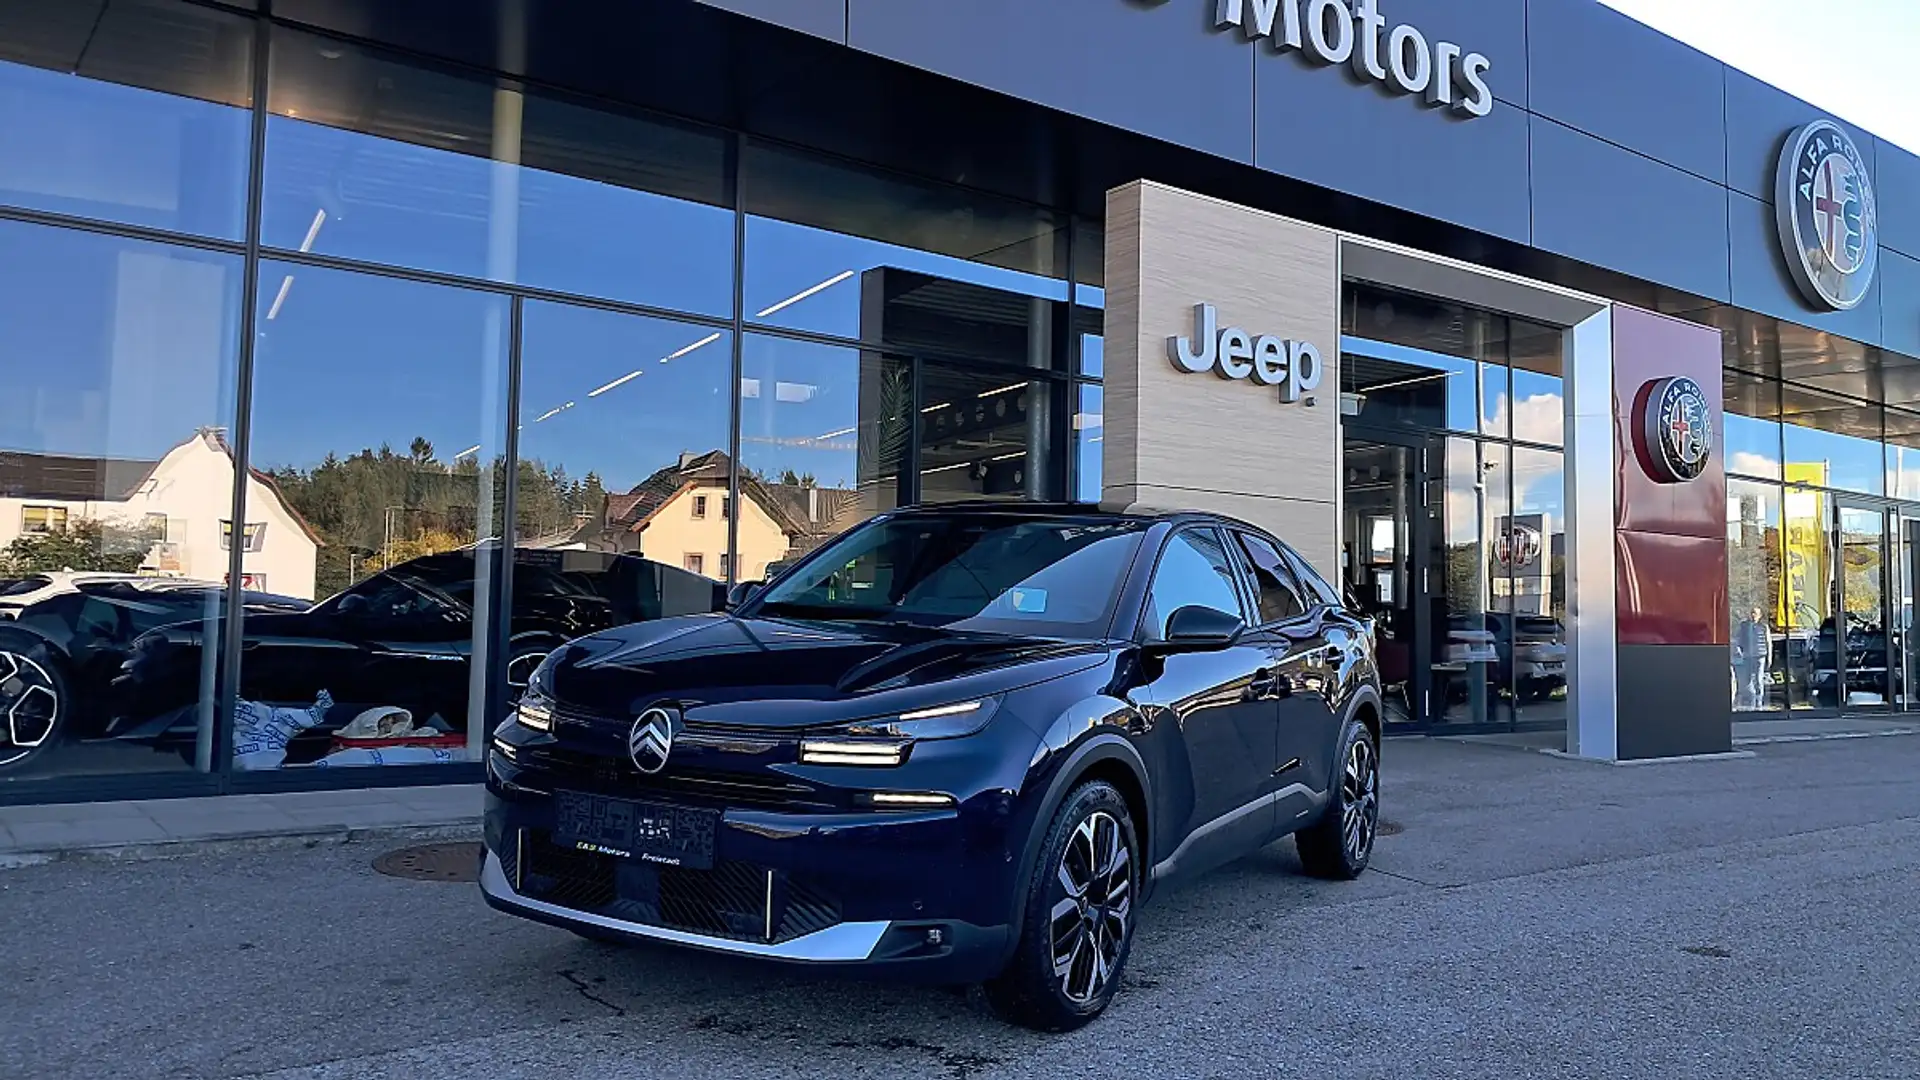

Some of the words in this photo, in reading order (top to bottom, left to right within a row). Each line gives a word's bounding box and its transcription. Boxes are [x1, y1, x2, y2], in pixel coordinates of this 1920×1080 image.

[1799, 136, 1829, 202] ALFA
[1168, 302, 1322, 403] Jeep
[1662, 386, 1681, 425] ALFA
[597, 845, 631, 858] Motors
